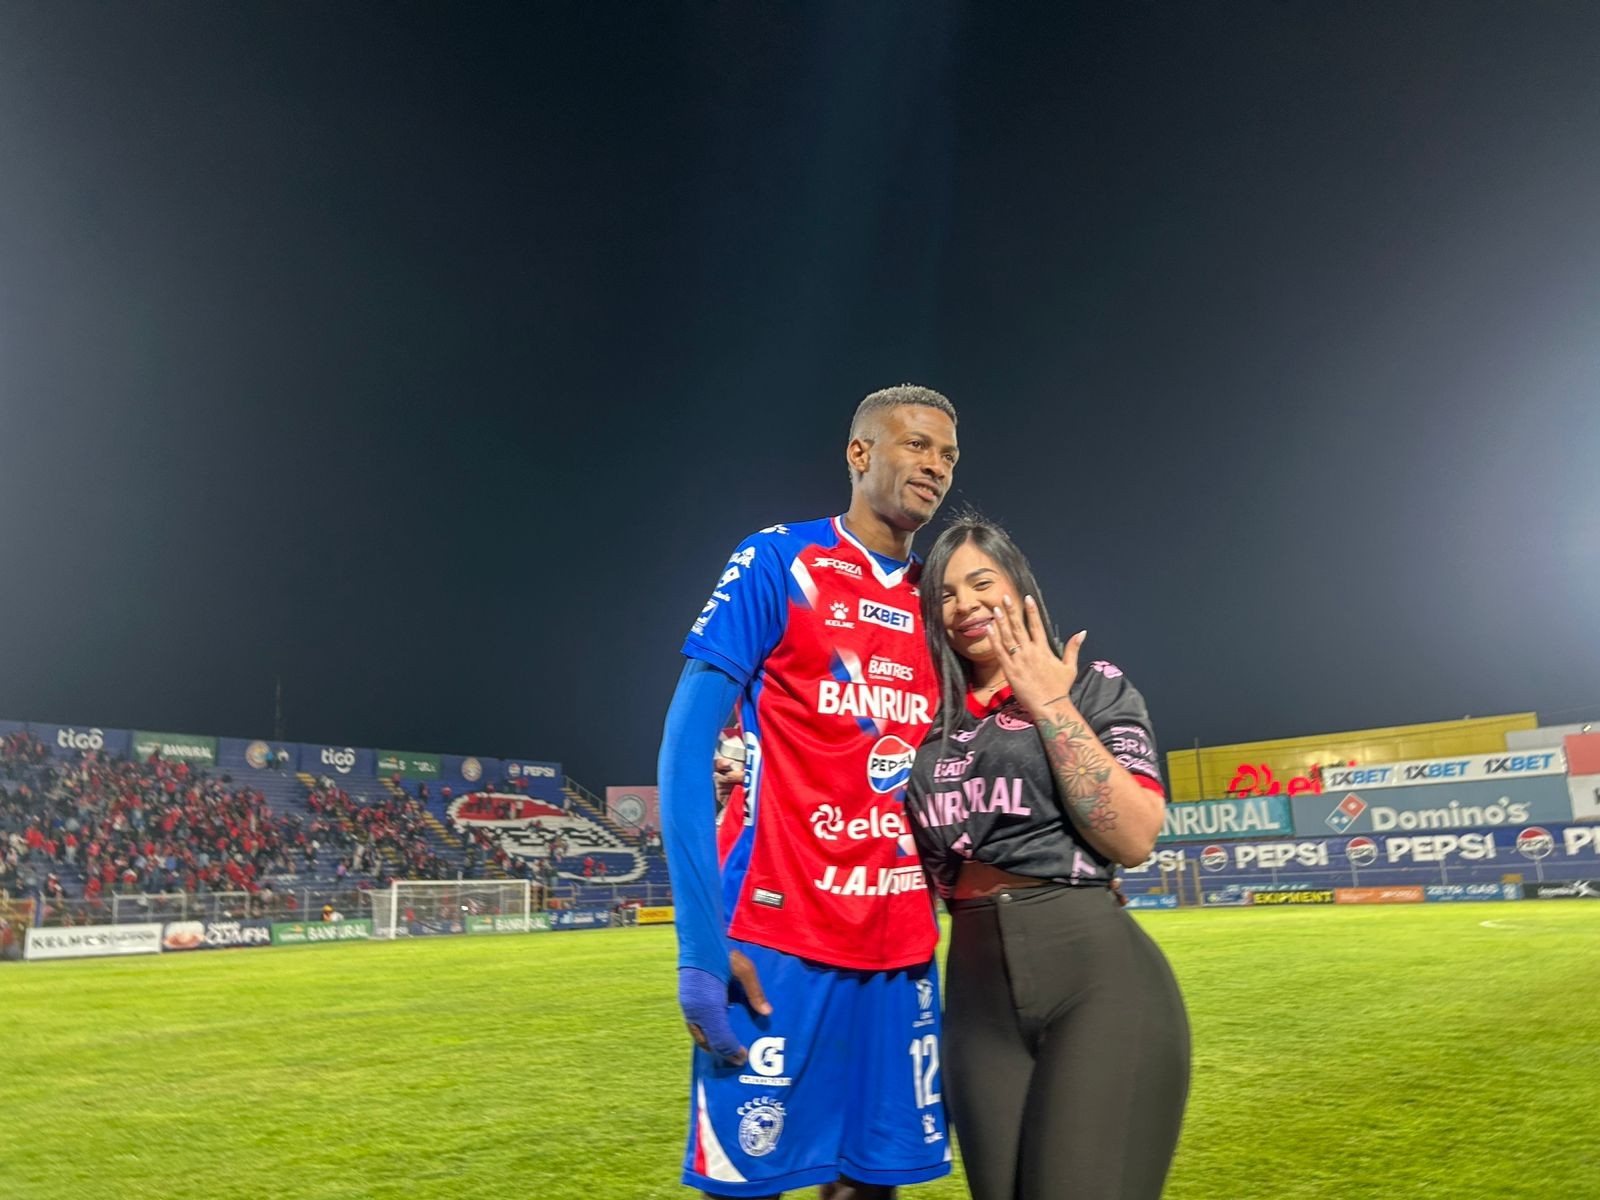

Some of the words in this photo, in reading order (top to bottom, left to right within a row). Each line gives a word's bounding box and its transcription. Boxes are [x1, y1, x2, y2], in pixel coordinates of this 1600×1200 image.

[863, 604, 910, 627] 1XBET
[868, 659, 914, 681] BATRES
[522, 765, 556, 778] PEPSI
[1403, 760, 1470, 780] 1XBET
[1483, 753, 1555, 774] 1XBET
[1329, 767, 1392, 787] 1XBET
[1158, 801, 1280, 836] NRURAL
[1370, 796, 1532, 832] Domino's
[1235, 841, 1328, 869] PEPSI
[1385, 832, 1497, 863] PEPSI
[909, 1034, 942, 1109] 12
